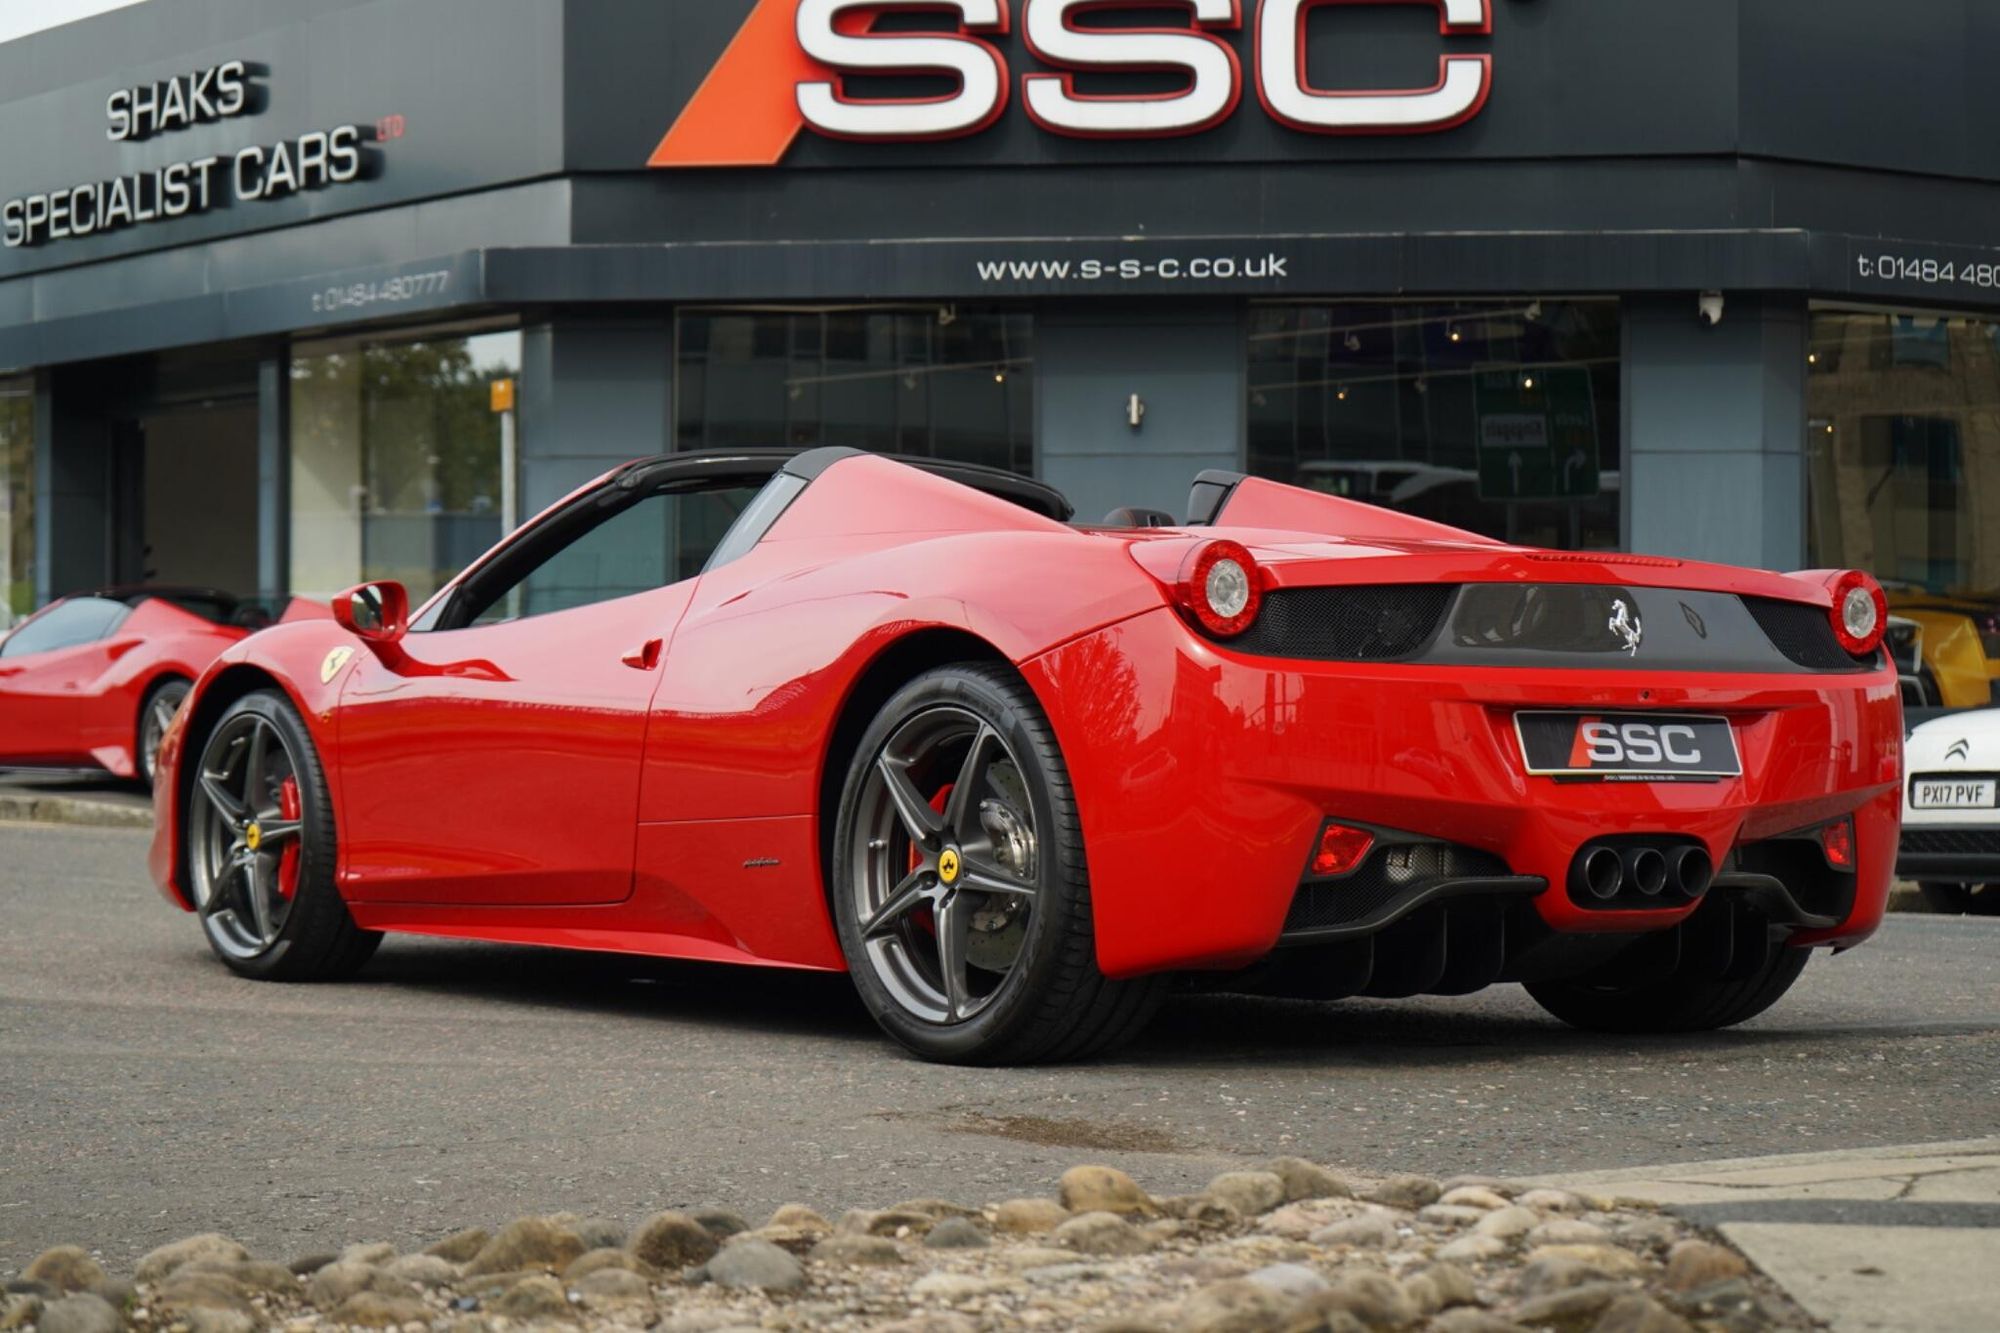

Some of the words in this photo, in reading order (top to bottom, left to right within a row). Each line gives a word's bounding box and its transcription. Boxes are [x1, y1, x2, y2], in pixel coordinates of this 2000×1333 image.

[106, 60, 246, 141] SHAKS
[794, 0, 1492, 140] SSC
[2, 156, 218, 248] SPECIALIST
[233, 125, 360, 201] CARS
[976, 252, 1288, 281] www.s-s-c.co.uk
[1582, 721, 1702, 764] SSC
[1922, 784, 1952, 803] PX17
[1955, 784, 1985, 803] PVF
